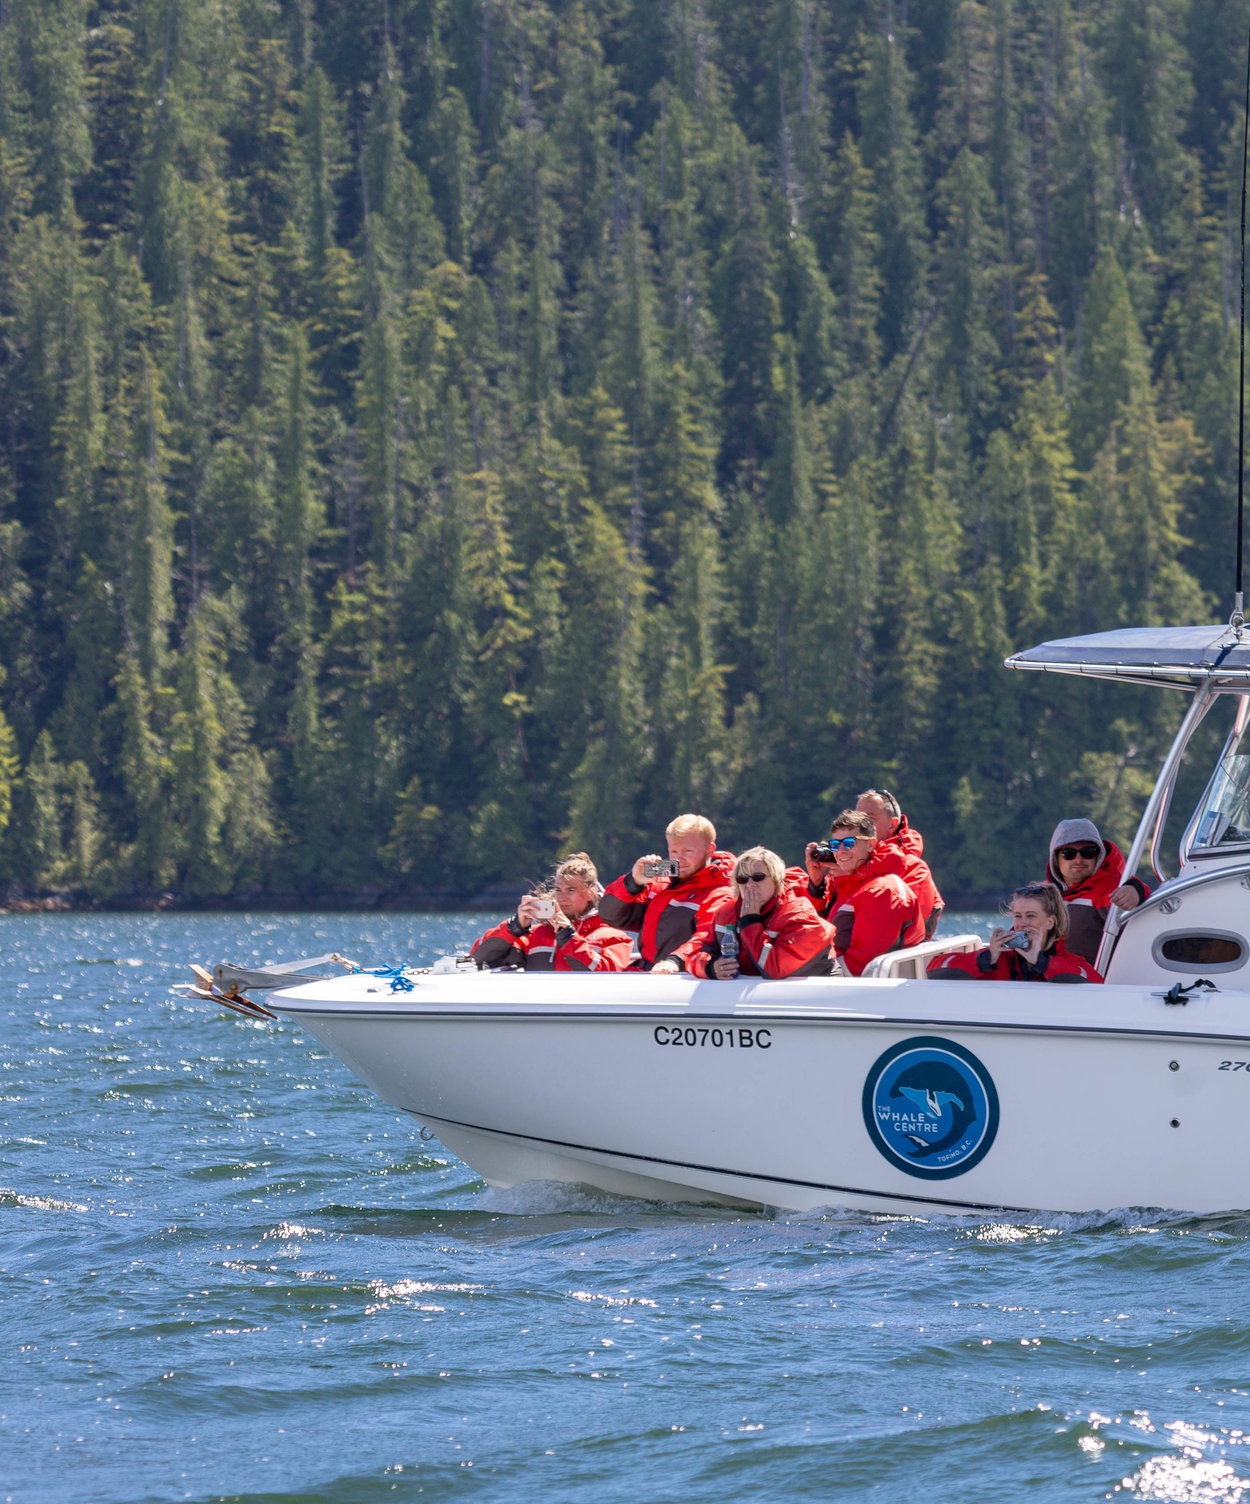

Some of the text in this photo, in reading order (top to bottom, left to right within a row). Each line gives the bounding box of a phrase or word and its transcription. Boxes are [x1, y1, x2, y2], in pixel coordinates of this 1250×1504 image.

[654, 1026, 772, 1049] C20701BC
[878, 1112, 925, 1122] WHALE
[894, 1122, 938, 1133] CENTRE
